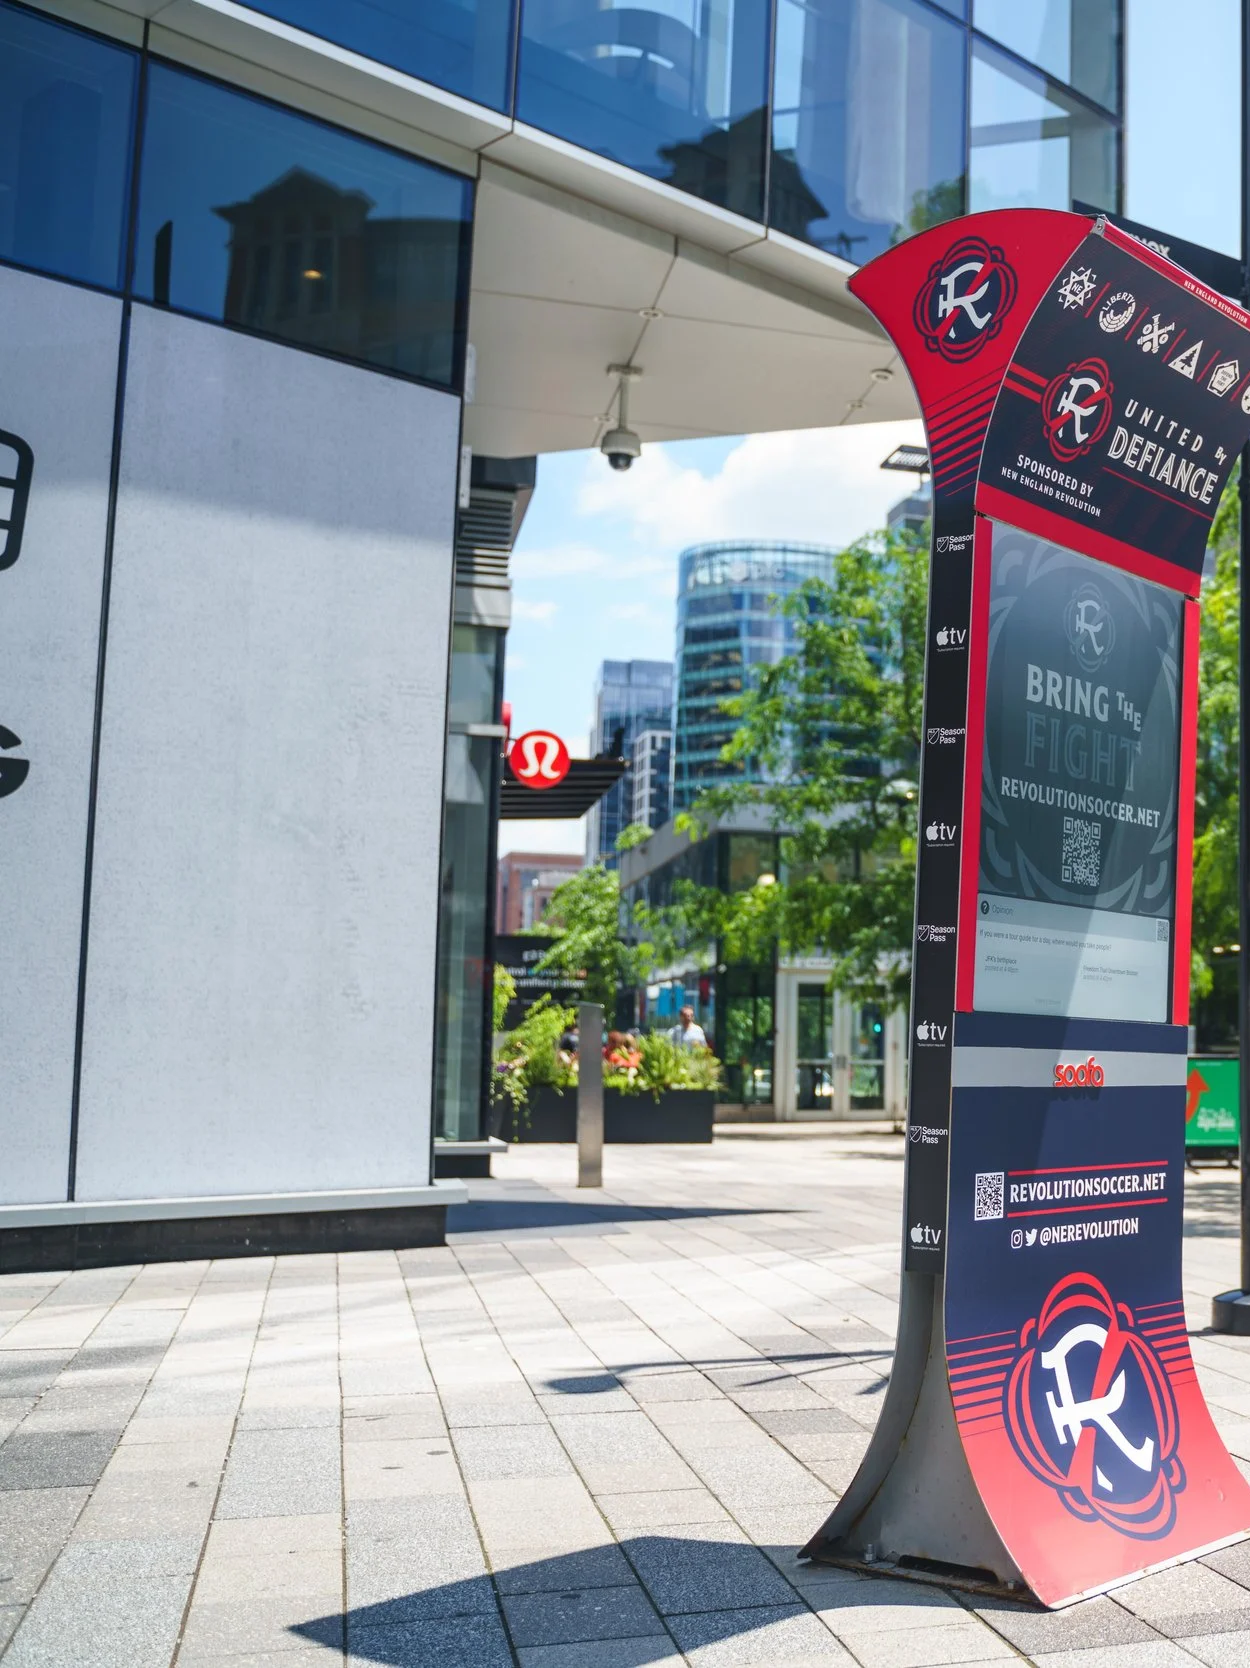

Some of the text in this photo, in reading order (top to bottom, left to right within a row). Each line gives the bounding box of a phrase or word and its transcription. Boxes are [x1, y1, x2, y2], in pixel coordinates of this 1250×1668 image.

[1102, 292, 1136, 312] LIBERTY
[1184, 280, 1248, 324] NEW ENGLAND REVOLUTION
[1125, 399, 1203, 453] UNITED
[1107, 425, 1219, 505] DEFIANCE
[1016, 454, 1094, 498] SPONSORED BY
[1001, 466, 1101, 518] NEW ENGLAND REVOLUTION
[949, 533, 974, 544] Season
[949, 543, 965, 552] Pass
[950, 627, 967, 645] tv
[1026, 663, 1142, 732] BRING THE
[940, 727, 966, 737] Season
[940, 736, 956, 744] Pass
[1025, 711, 1142, 791] FIGHT
[1001, 776, 1160, 828] REVOLUTIONSOCCER.NET
[939, 822, 956, 840] tv
[992, 904, 1013, 916] Opinion
[930, 925, 956, 934] Season
[930, 933, 946, 942] Pass
[930, 1022, 947, 1041] tv
[922, 1126, 948, 1136] Season
[922, 1135, 939, 1144] Pass
[1010, 1172, 1167, 1203] REVOLUTIONSOCCER.NET
[924, 1225, 942, 1245] tv
[1040, 1218, 1139, 1246] @NEREVOLUTION
